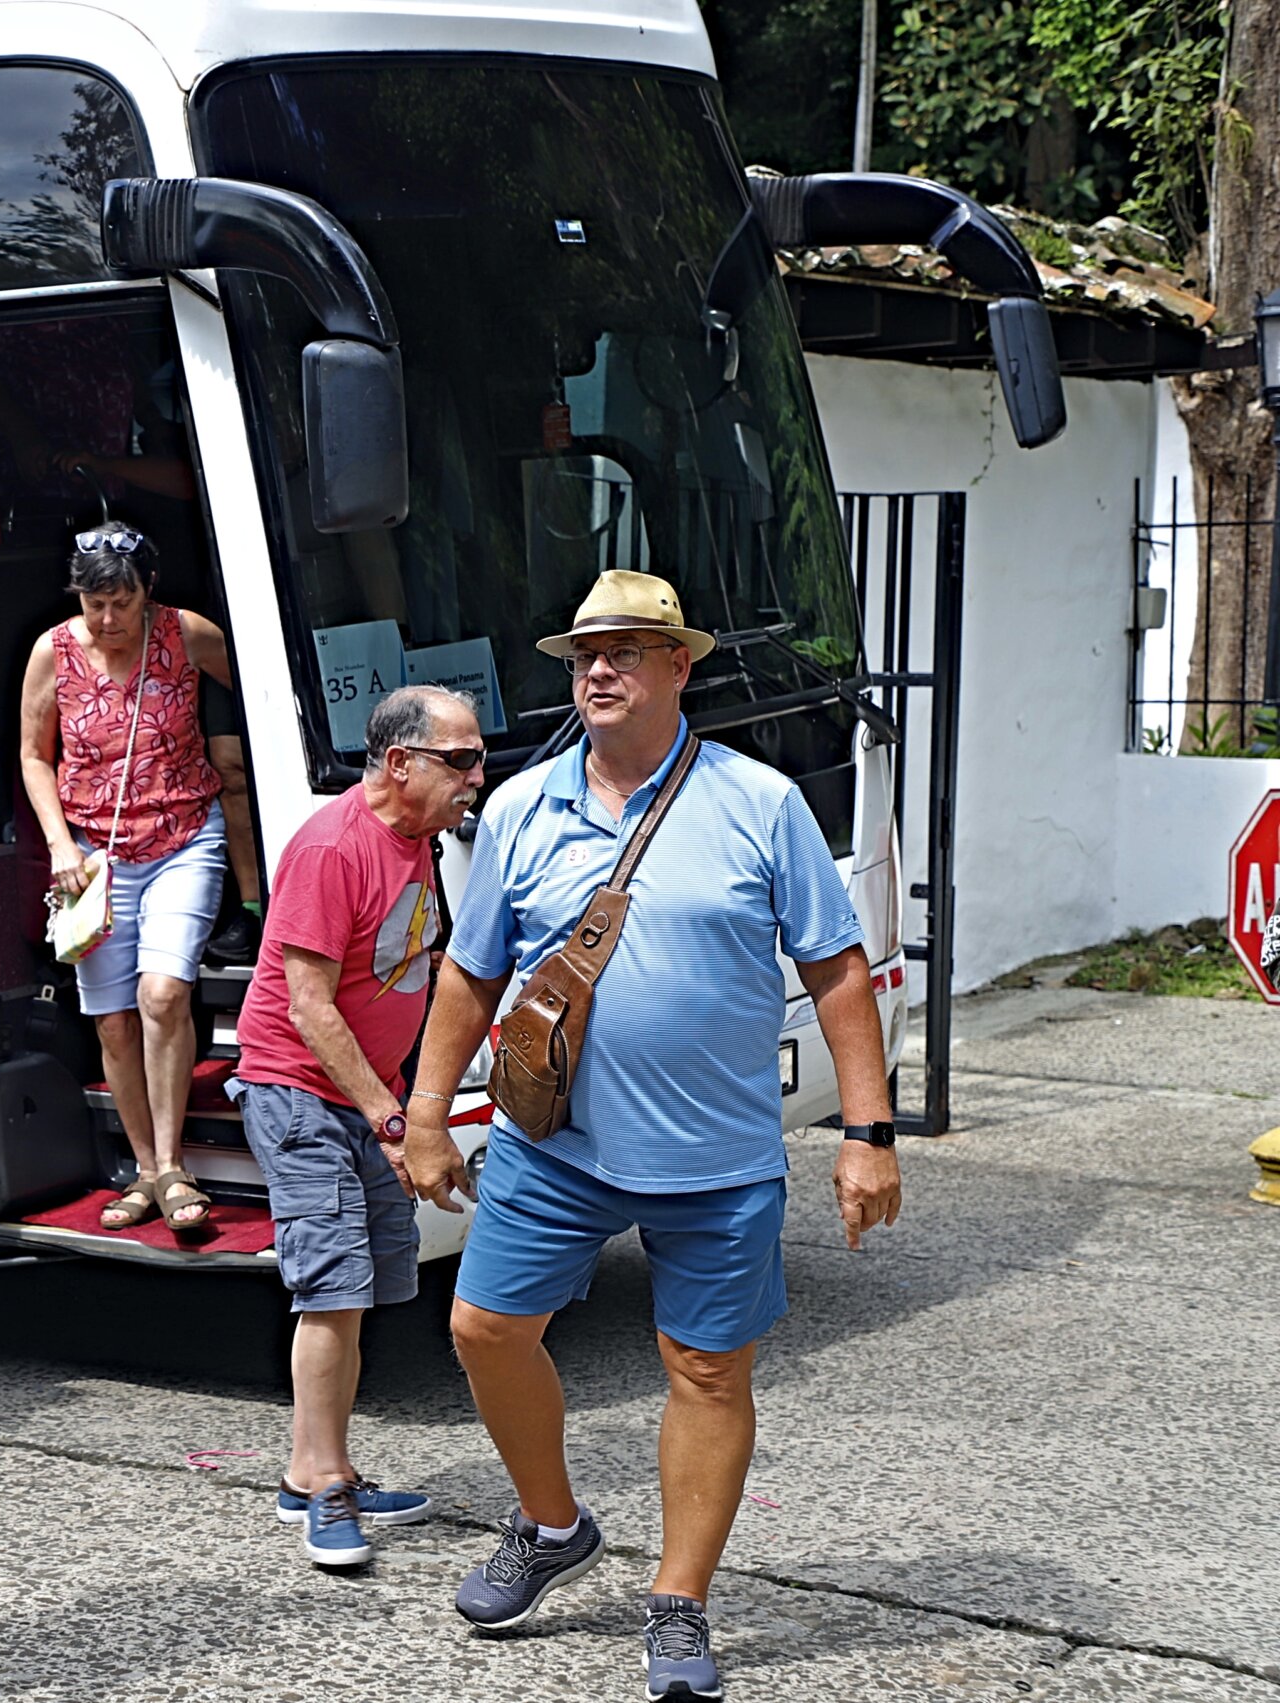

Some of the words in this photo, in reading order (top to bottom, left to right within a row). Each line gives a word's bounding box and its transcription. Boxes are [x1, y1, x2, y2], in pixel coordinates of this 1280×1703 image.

[327, 675, 358, 704] 35
[368, 668, 387, 694] A
[458, 671, 485, 684] Panama
[1242, 862, 1280, 934] A
